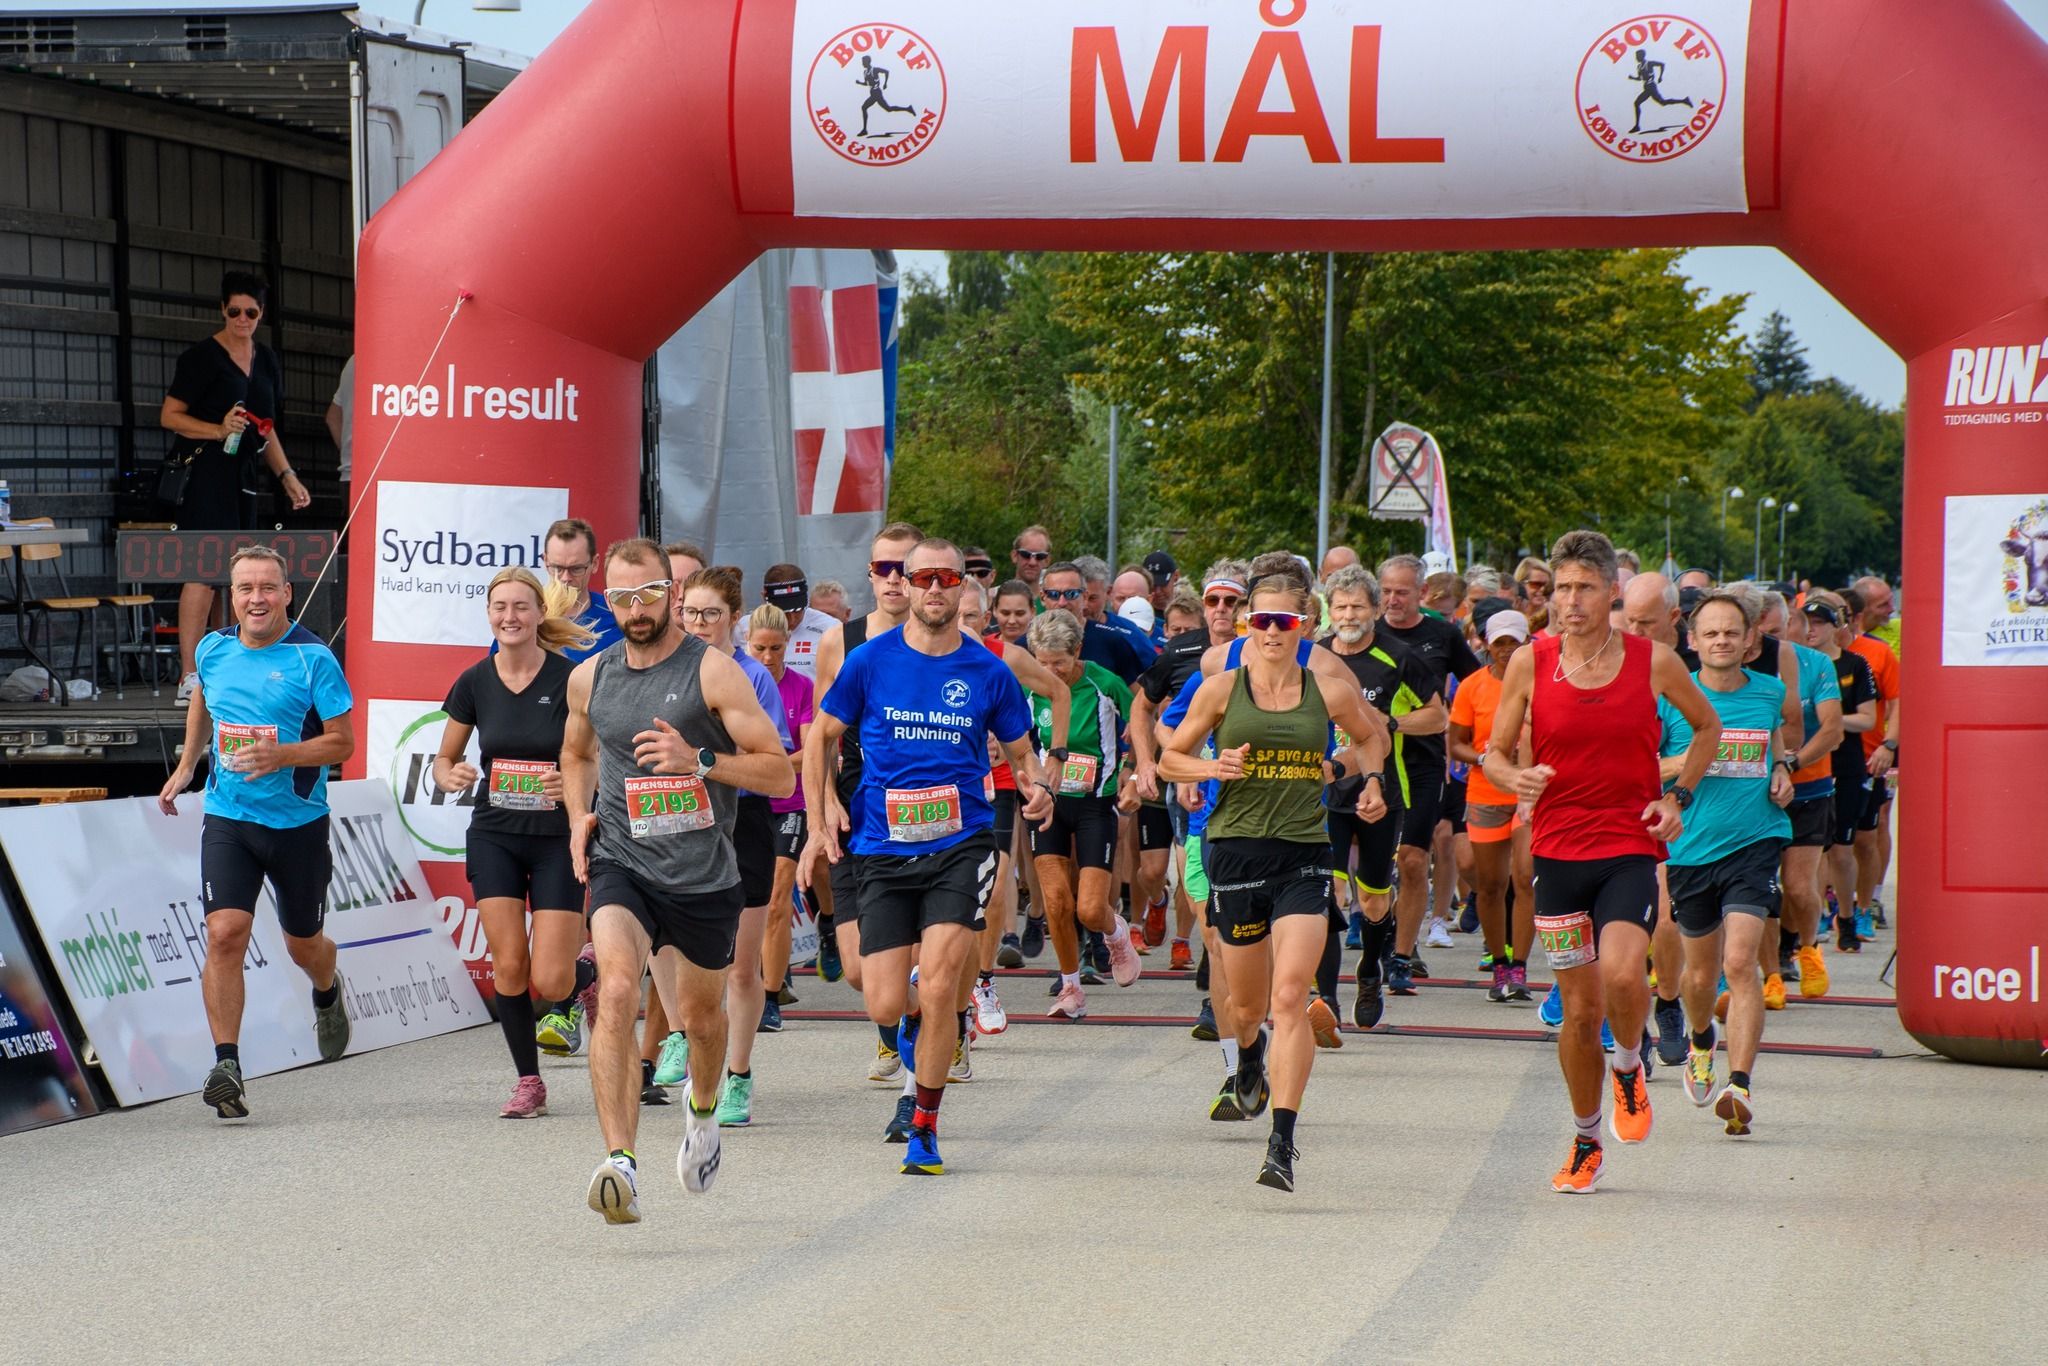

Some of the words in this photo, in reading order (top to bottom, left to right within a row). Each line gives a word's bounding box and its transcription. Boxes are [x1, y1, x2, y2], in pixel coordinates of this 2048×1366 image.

[828, 28, 894, 68] BOV
[897, 39, 932, 71] IF
[1600, 20, 1671, 64] BOV
[1673, 28, 1711, 60] IF
[1070, 0, 1445, 163] MÅL
[816, 106, 847, 146] LØB
[847, 141, 866, 156] &
[868, 108, 937, 160] MOTION
[1584, 104, 1618, 144] LØB
[1617, 138, 1637, 153] &
[1640, 98, 1715, 156] MOTION
[1944, 412, 2011, 425] TIDTAGNING
[2014, 411, 2042, 423] MED
[382, 528, 545, 573] Sydbank
[381, 576, 412, 592] Hvad
[417, 577, 443, 593] kan
[447, 580, 460, 595] vi
[465, 583, 489, 599] gø
[2008, 615, 2048, 627] økologi
[1985, 628, 2048, 646] NATUR
[883, 706, 924, 722] Team
[929, 711, 973, 727] Meins
[223, 736, 257, 755] 217
[894, 727, 961, 744] RUNning
[1720, 732, 1768, 740] ÆNSELØBET
[1068, 756, 1095, 764] ELØBET
[1277, 750, 1301, 762] BYG
[1716, 742, 1762, 762] 2199
[492, 761, 556, 772] GRÆNSELØBET
[498, 772, 545, 793] 2165
[639, 791, 698, 816] 2195
[887, 788, 956, 800] GRÆNSELØBET
[897, 800, 950, 824] 2189
[147, 918, 182, 963] med
[1540, 928, 1584, 951] 2121
[427, 961, 459, 1014] dig
